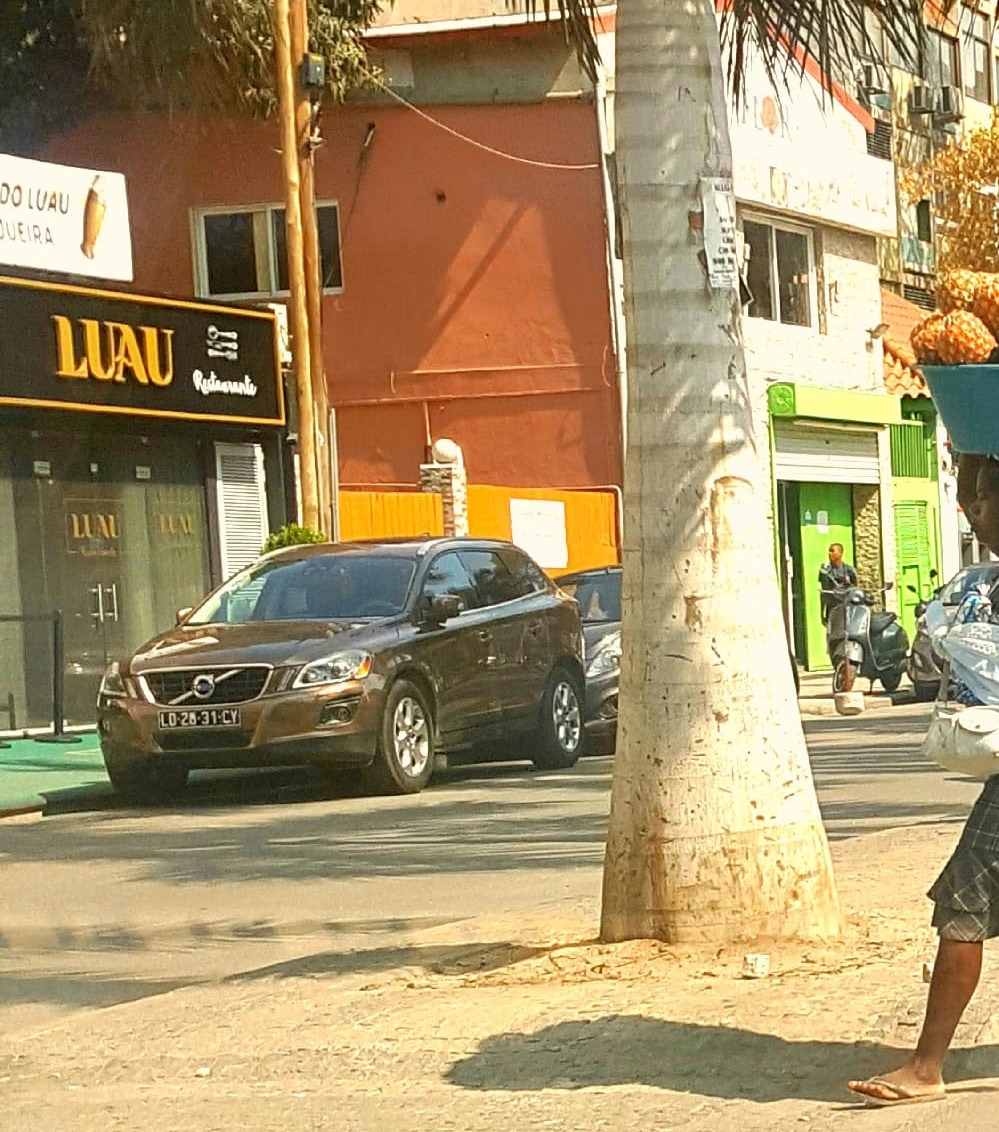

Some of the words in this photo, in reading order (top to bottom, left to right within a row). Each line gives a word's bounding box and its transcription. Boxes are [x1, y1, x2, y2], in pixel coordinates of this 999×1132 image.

[28, 187, 69, 215] LUAU
[52, 314, 175, 386] LUAU
[192, 368, 258, 396] Restaurante
[71, 513, 119, 539] LUAU
